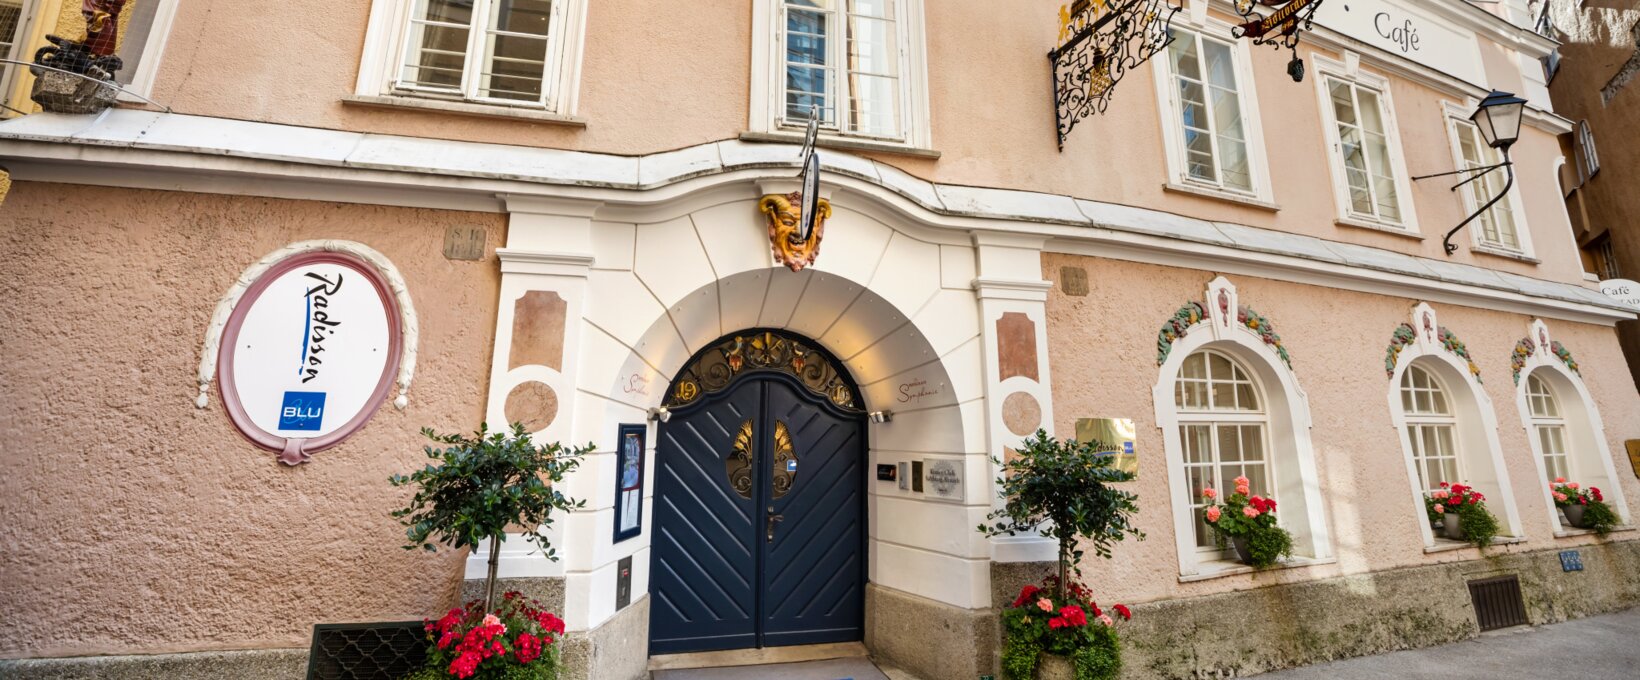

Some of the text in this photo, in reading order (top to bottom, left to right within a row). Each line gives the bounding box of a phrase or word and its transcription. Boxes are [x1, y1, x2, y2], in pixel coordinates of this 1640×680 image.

[1374, 12, 1419, 52] Café
[302, 272, 343, 383] Radisson
[675, 381, 697, 400] 19
[283, 406, 321, 418] BLU
